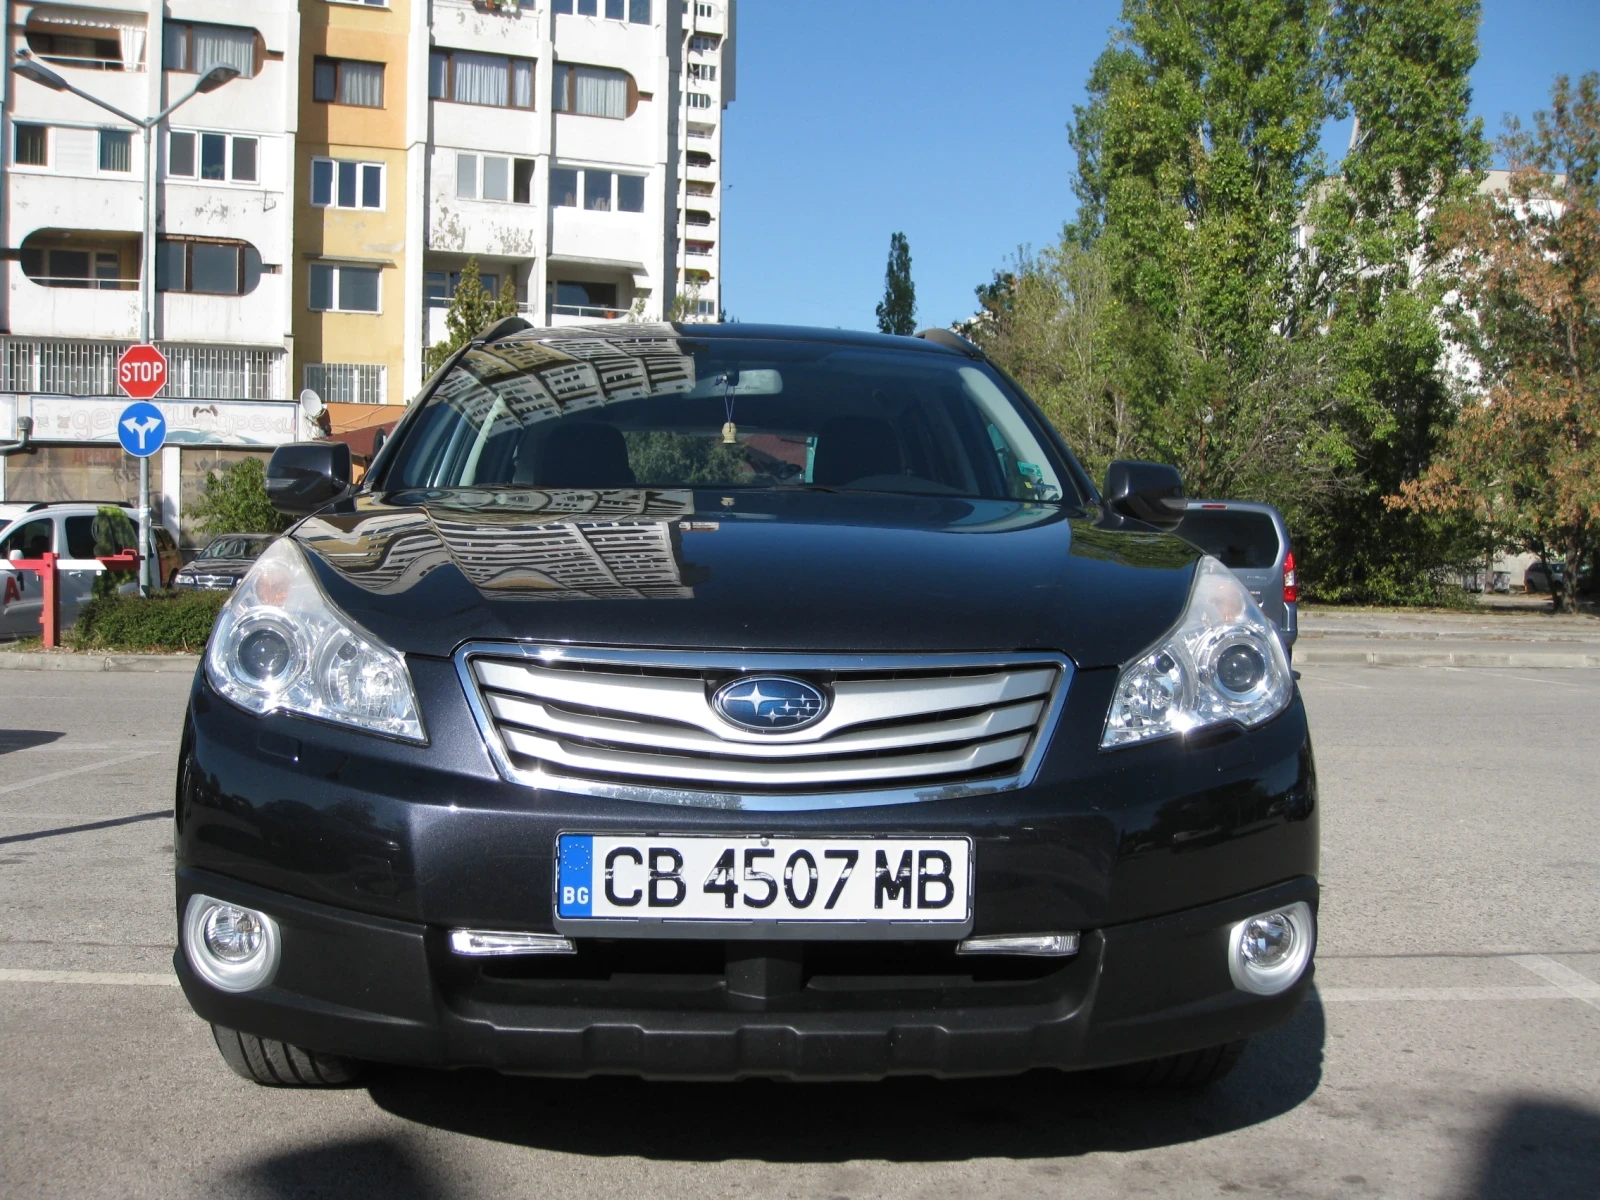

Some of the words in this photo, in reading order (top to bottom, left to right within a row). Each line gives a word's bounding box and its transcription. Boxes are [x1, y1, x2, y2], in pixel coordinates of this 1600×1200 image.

[121, 361, 163, 382] STOP
[72, 404, 194, 440] дети
[3, 571, 25, 604] A1
[604, 846, 687, 908] CB
[703, 847, 860, 910] 4507
[873, 848, 955, 910] MB
[562, 887, 589, 905] BG
